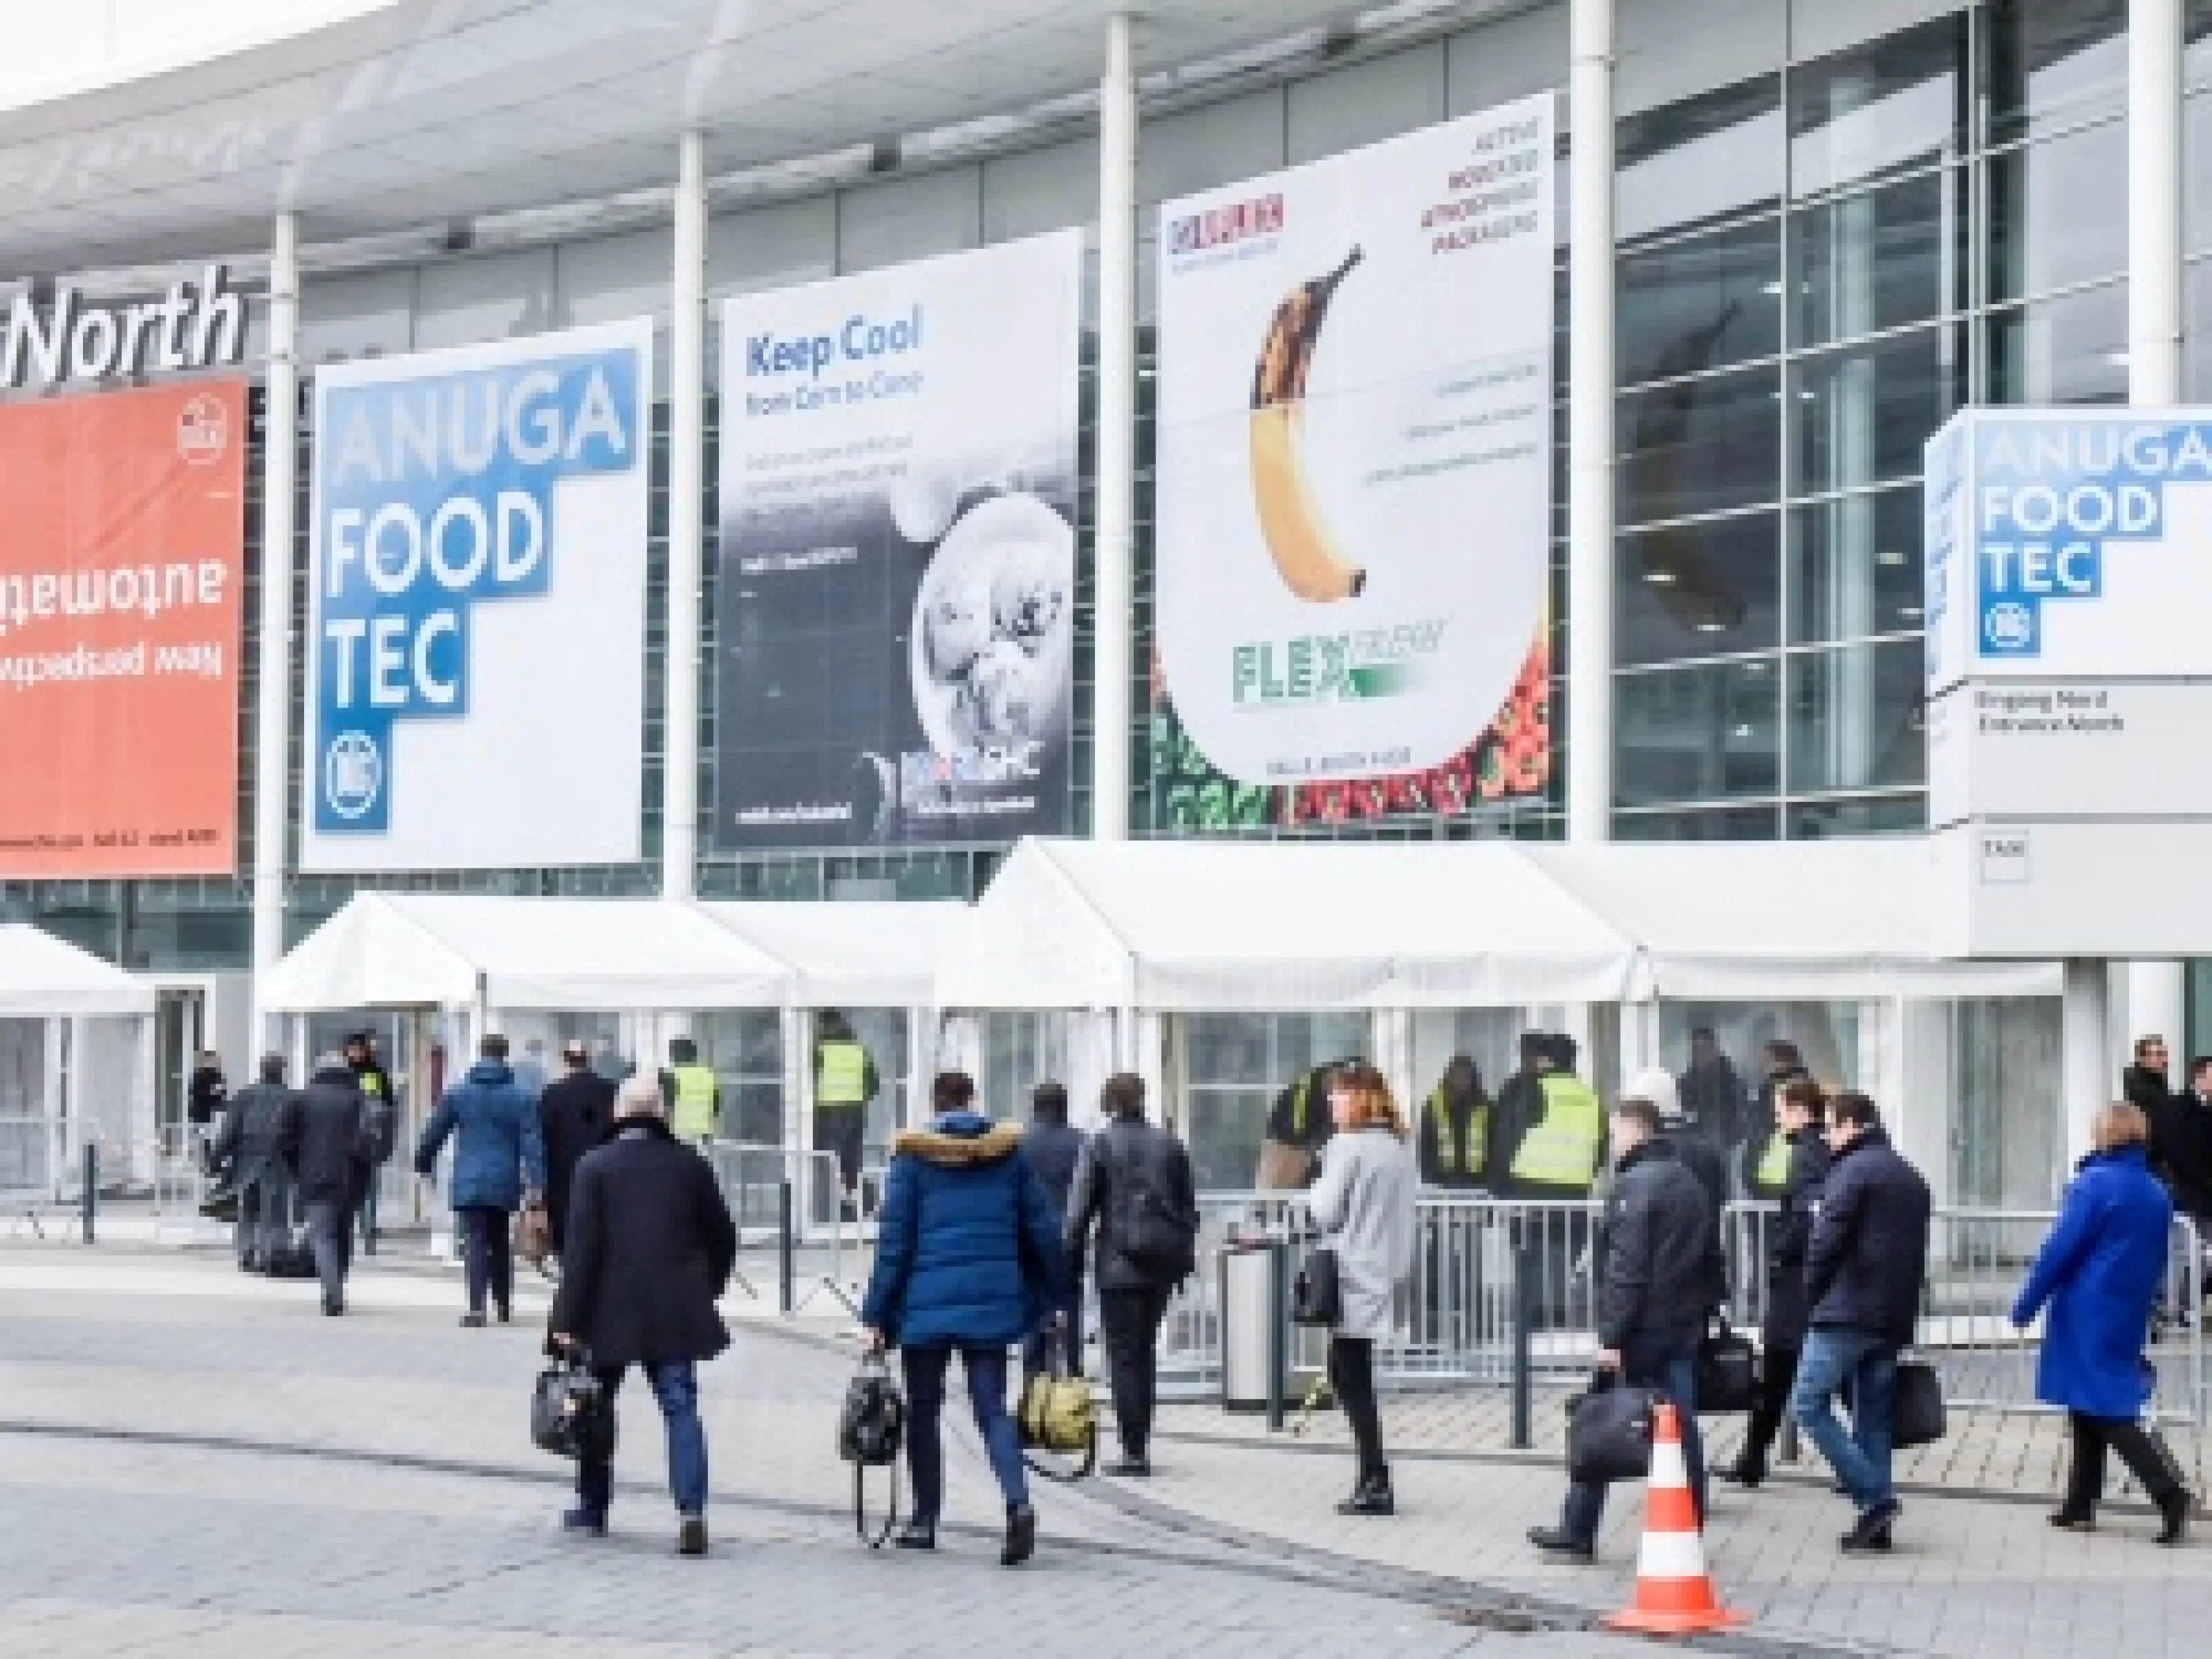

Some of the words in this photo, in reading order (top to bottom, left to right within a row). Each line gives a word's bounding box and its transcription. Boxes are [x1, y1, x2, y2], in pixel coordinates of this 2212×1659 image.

[0, 265, 241, 387] North
[747, 333, 830, 380] Keep
[840, 304, 923, 360] Cool
[331, 365, 627, 485] ANUGA
[1985, 425, 2212, 475] ANUGA
[327, 491, 543, 598] FOOD
[1985, 486, 2157, 532] FOOD
[1983, 543, 2091, 592] TEC
[154, 642, 222, 681] New
[326, 609, 460, 709] TEC
